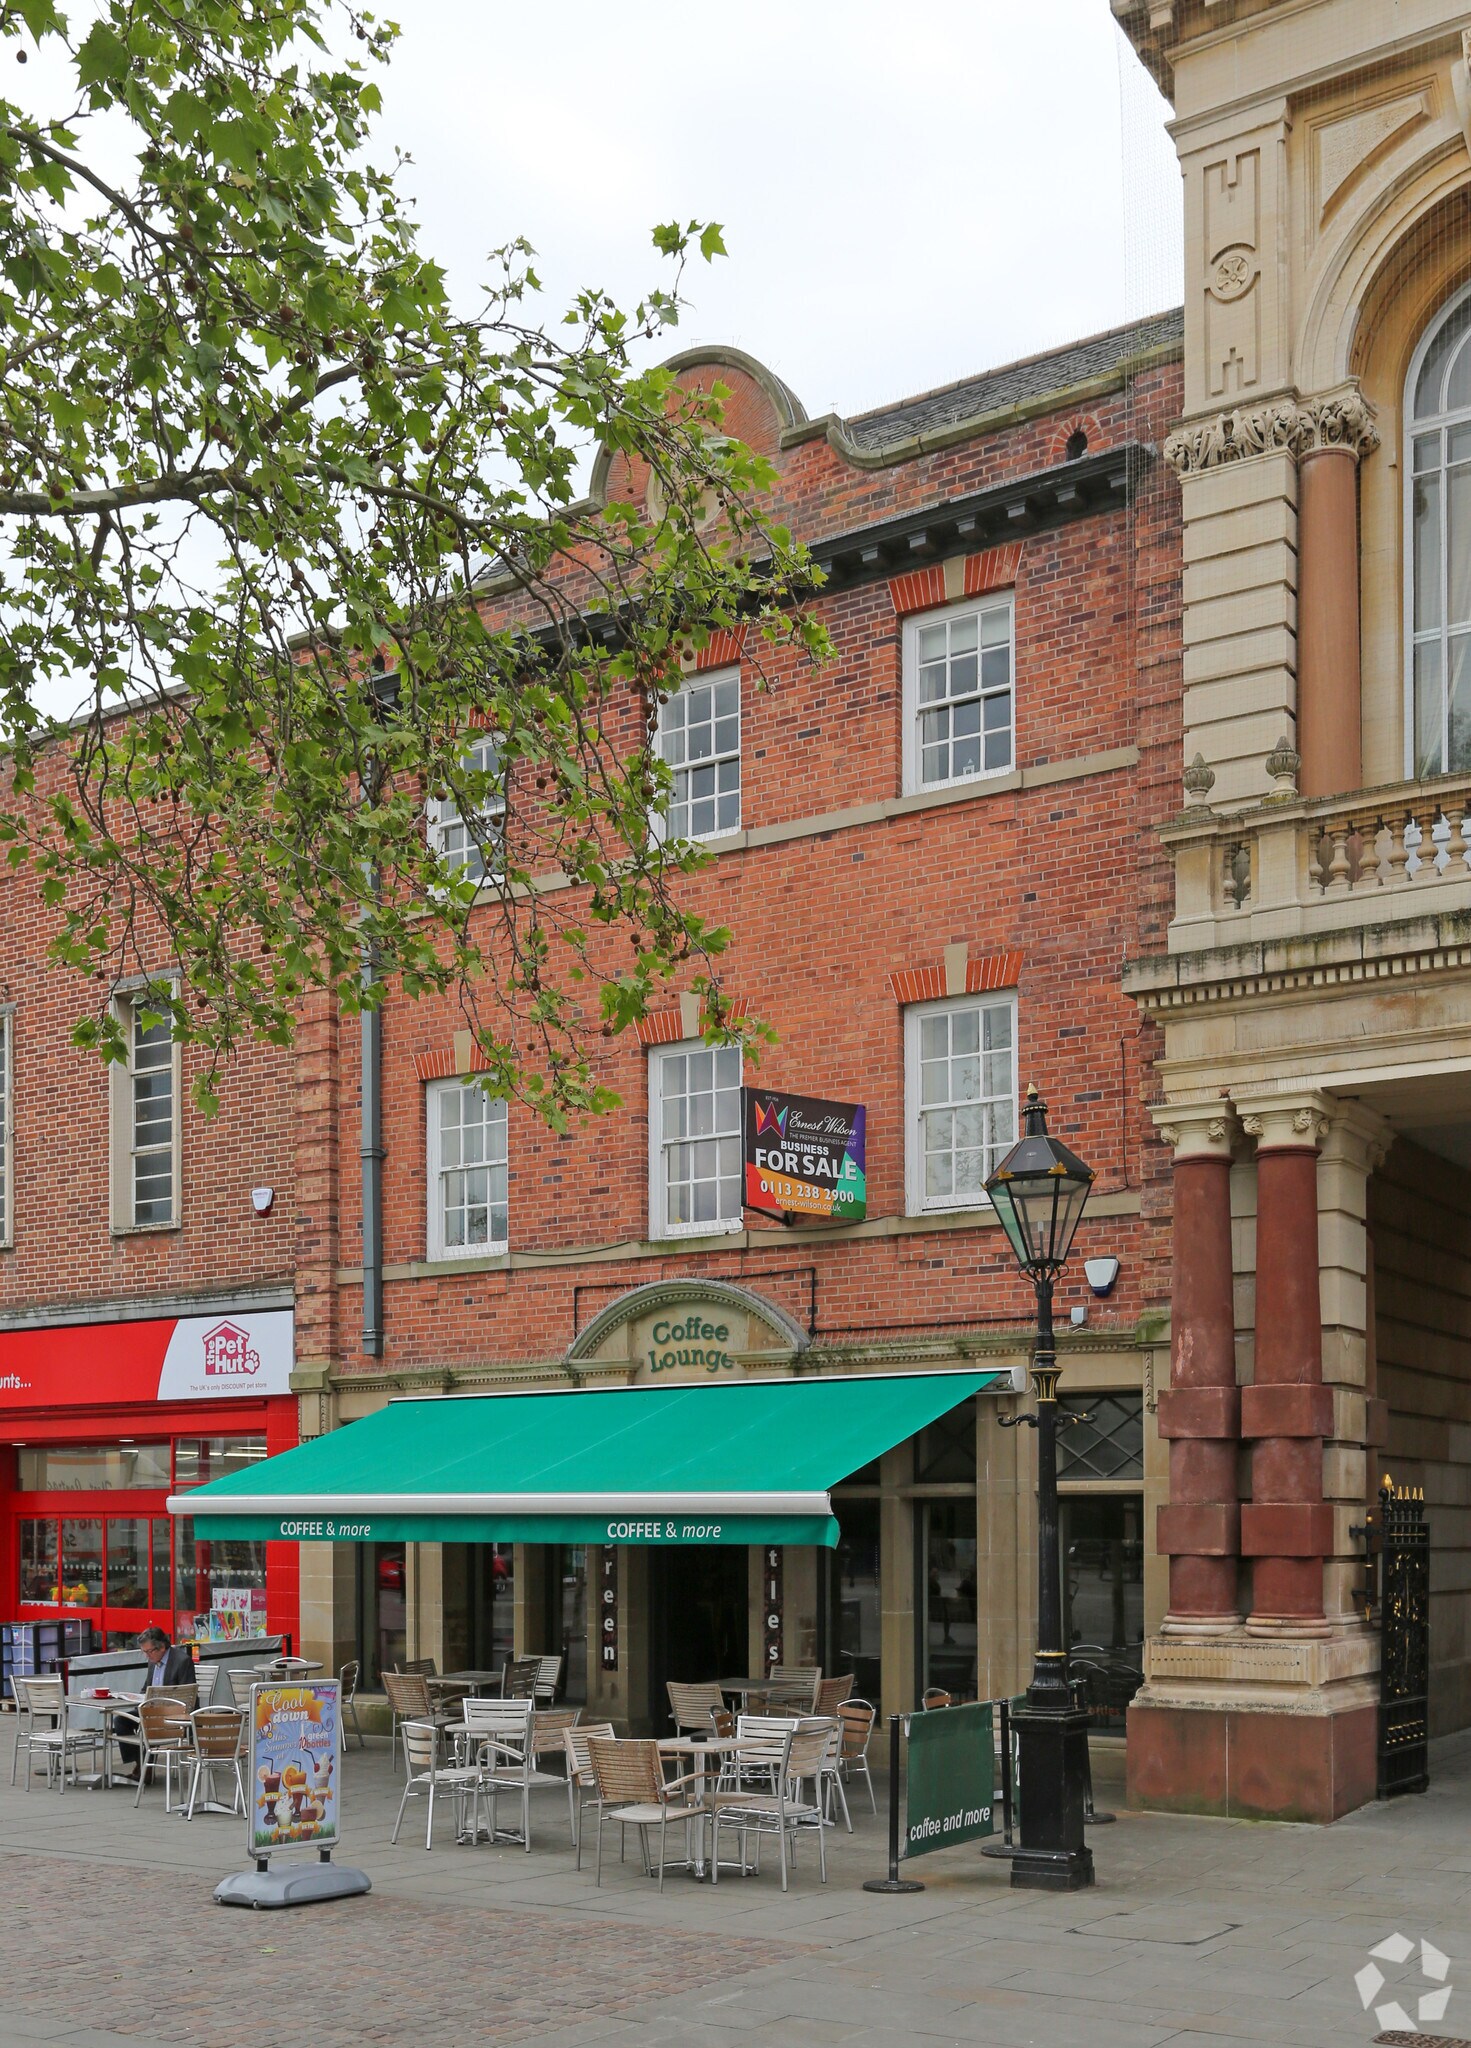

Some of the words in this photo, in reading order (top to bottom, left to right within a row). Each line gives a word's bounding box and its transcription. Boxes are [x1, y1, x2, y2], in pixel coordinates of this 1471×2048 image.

[789, 1110, 824, 1131] Ernest
[823, 1115, 857, 1136] Wilson
[781, 1140, 829, 1156] BUSINESS
[789, 1132, 799, 1140] THE
[800, 1133, 818, 1143] PREMIER
[840, 1140, 857, 1148] AGENT
[755, 1148, 799, 1174] FOR
[802, 1155, 857, 1181] SALE
[760, 1180, 793, 1196] 0113
[797, 1183, 820, 1199] 238
[823, 1187, 855, 1203] 2900
[775, 1197, 842, 1212] ernest-wilson.co.uk
[652, 1316, 729, 1345] Coffee
[207, 1340, 215, 1366] the
[215, 1335, 244, 1355] Pet
[215, 1354, 244, 1373] Hut
[648, 1348, 734, 1373] Lounge
[221, 1382, 246, 1390] DISCOUNT
[280, 1521, 323, 1536] COFFEE
[326, 1521, 335, 1536] &
[338, 1524, 371, 1537] more
[607, 1522, 661, 1538] COFFEE
[665, 1522, 677, 1538] &
[682, 1523, 722, 1538] more
[603, 1544, 615, 1661] reen
[266, 1687, 307, 1713] Cool
[272, 1710, 309, 1724] down
[306, 1739, 331, 1749] bottles
[307, 1730, 329, 1741] green
[910, 1817, 941, 1841] coffee
[943, 1809, 963, 1832] and
[964, 1806, 990, 1827] more
